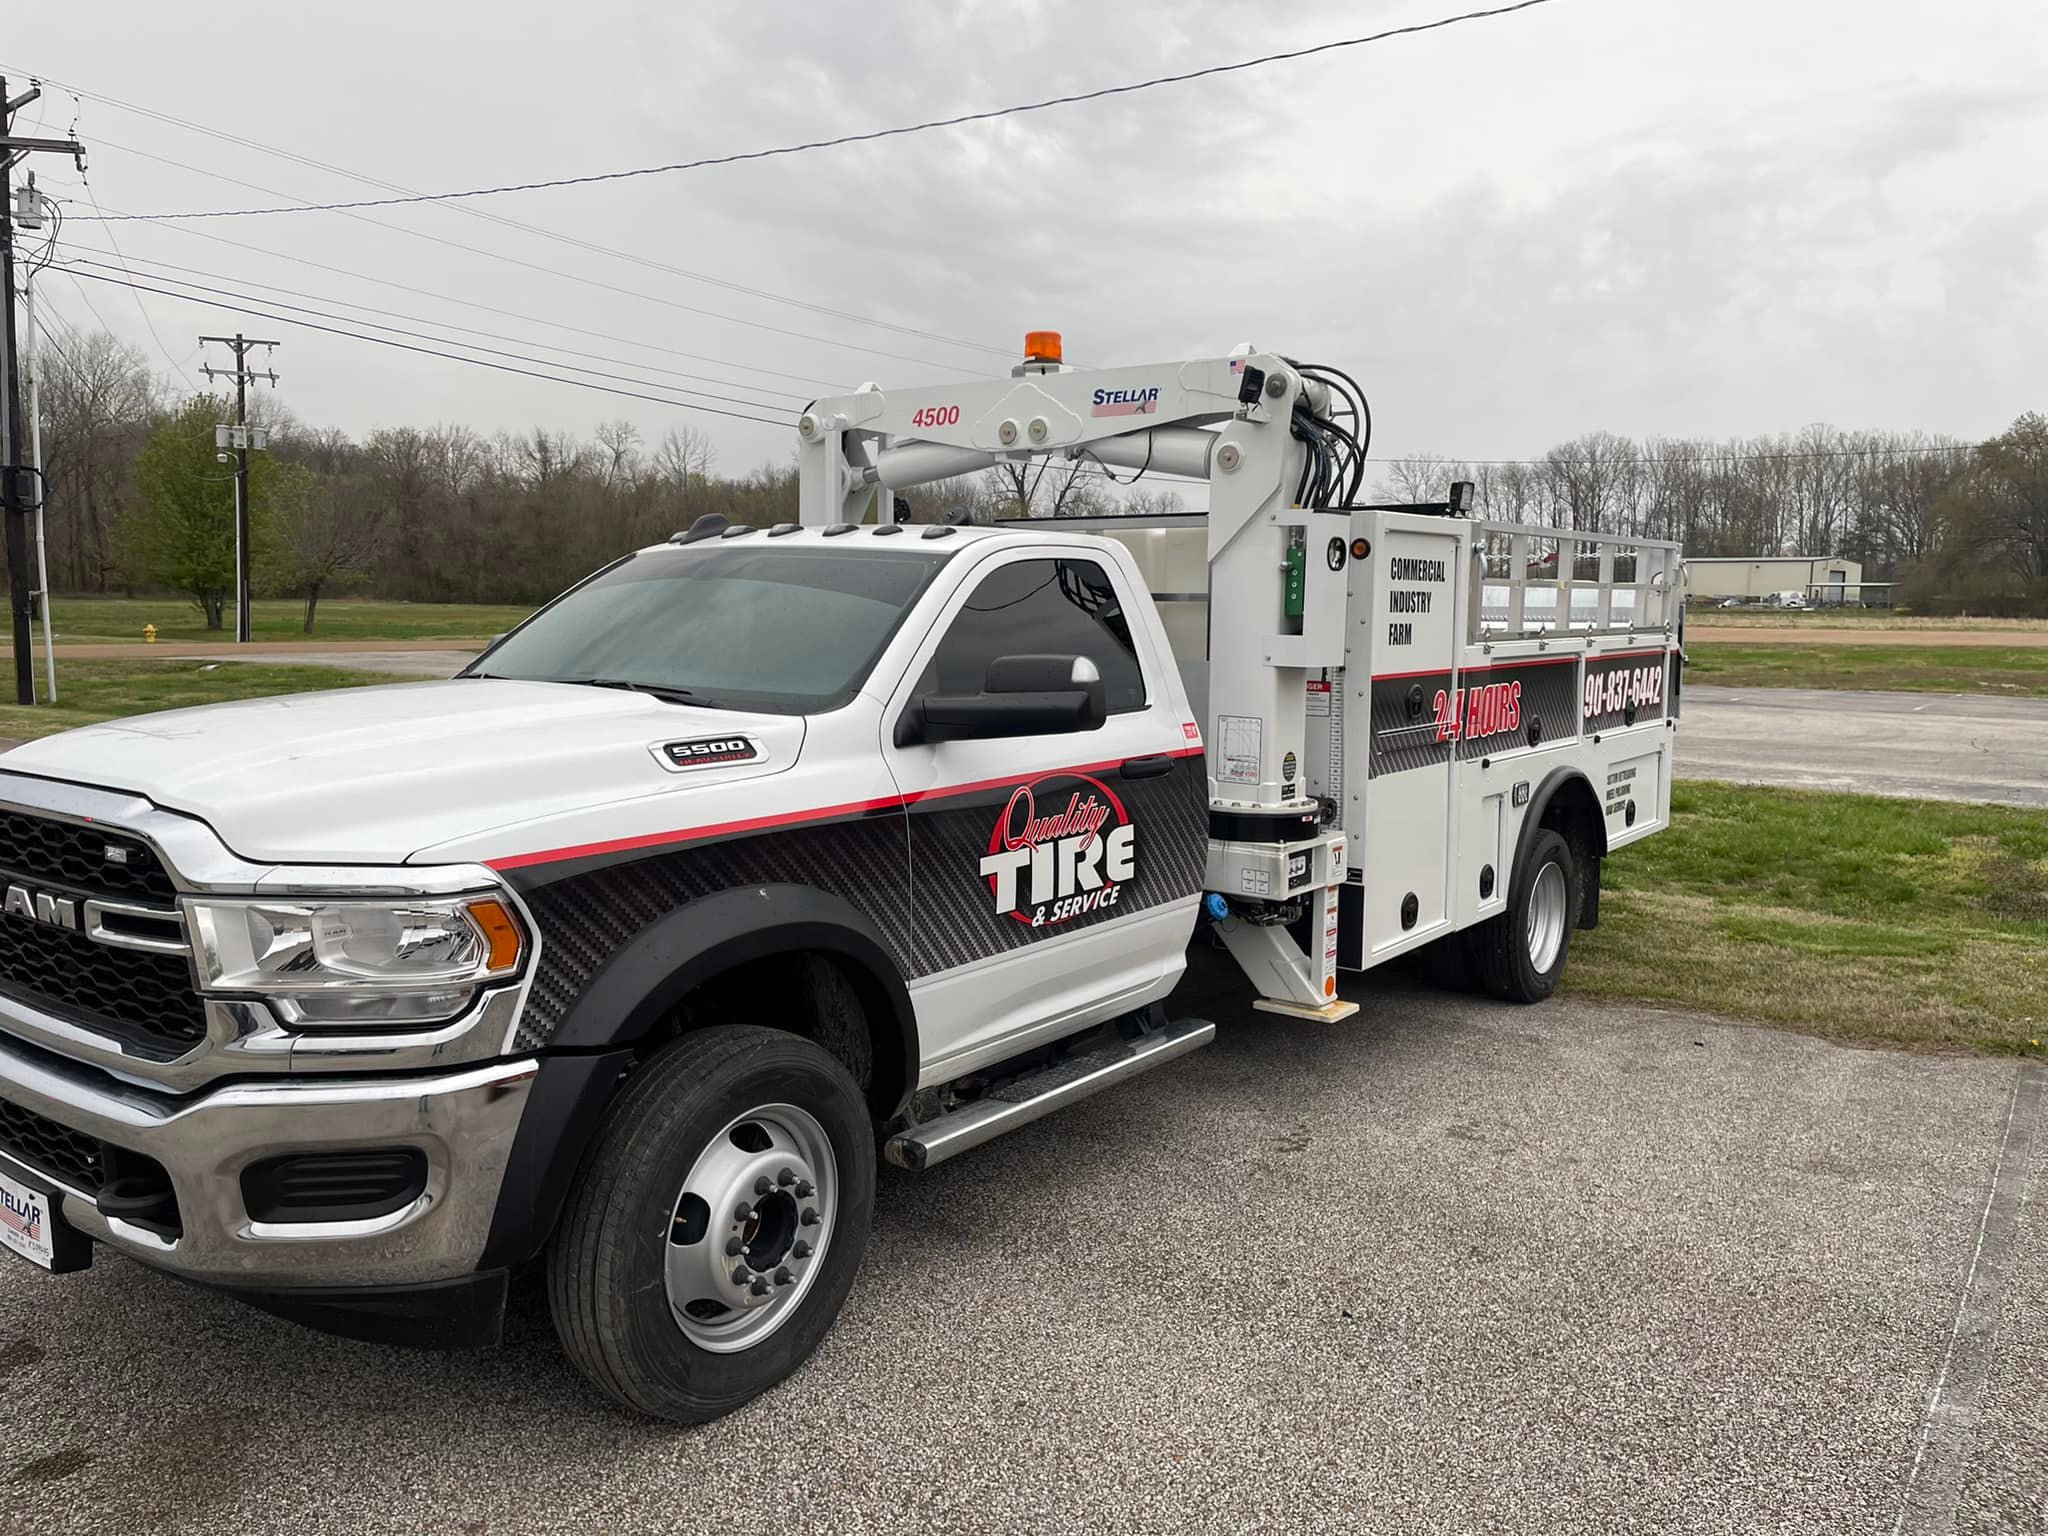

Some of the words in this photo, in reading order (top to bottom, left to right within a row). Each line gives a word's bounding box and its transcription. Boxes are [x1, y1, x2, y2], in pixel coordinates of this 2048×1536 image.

[1092, 388, 1159, 405] STELLAR
[912, 406, 960, 427] 4500
[1390, 557, 1446, 582] COMMERCIAL
[1389, 590, 1432, 613] INDUSTRY
[1388, 623, 1412, 646] FARM
[1433, 688, 1466, 742] 24
[1466, 680, 1521, 740] HOURS
[672, 740, 745, 757] 5500
[1003, 786, 1110, 853] Quality
[980, 824, 1135, 915] TIRE
[0, 885, 76, 930] AM
[1031, 905, 1046, 928] &
[1050, 885, 1121, 922] SERVICE
[0, 1187, 40, 1225] TELLAR
